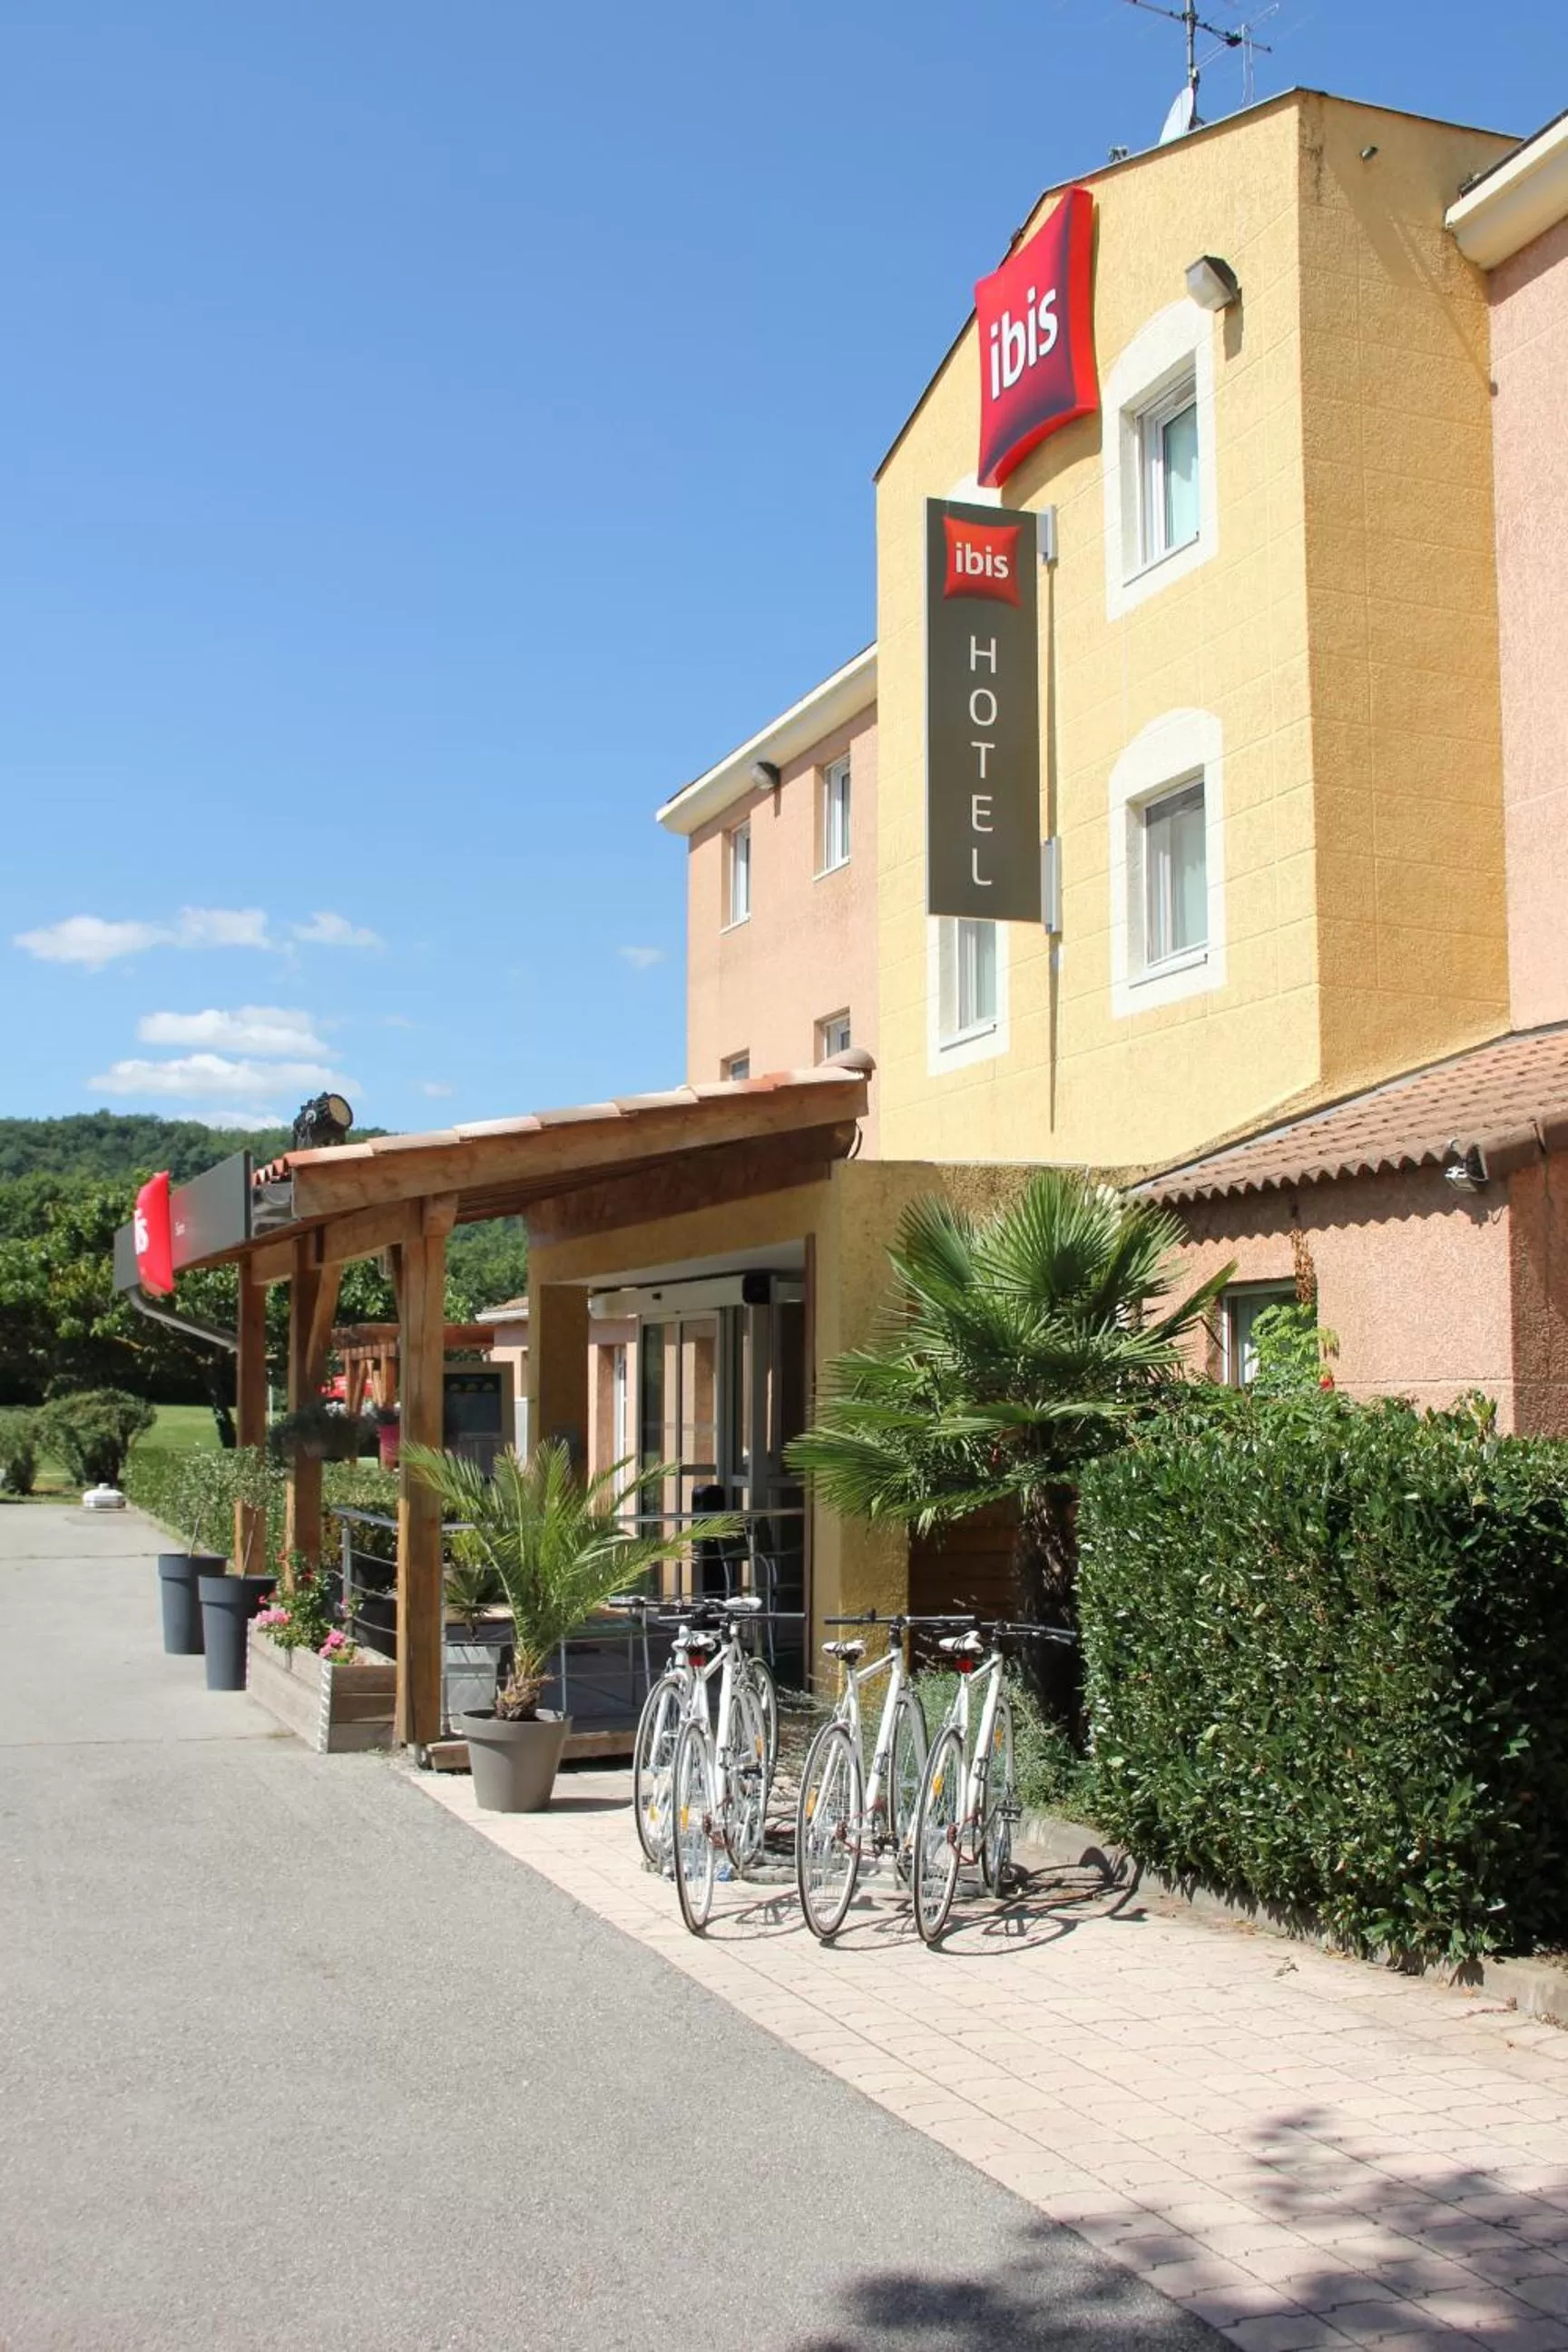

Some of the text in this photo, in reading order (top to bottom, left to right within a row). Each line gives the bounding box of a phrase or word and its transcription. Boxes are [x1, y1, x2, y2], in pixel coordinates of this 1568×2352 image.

[990, 285, 1058, 400] ibis
[956, 541, 1009, 578] ibis
[969, 635, 997, 886] HOTEL
